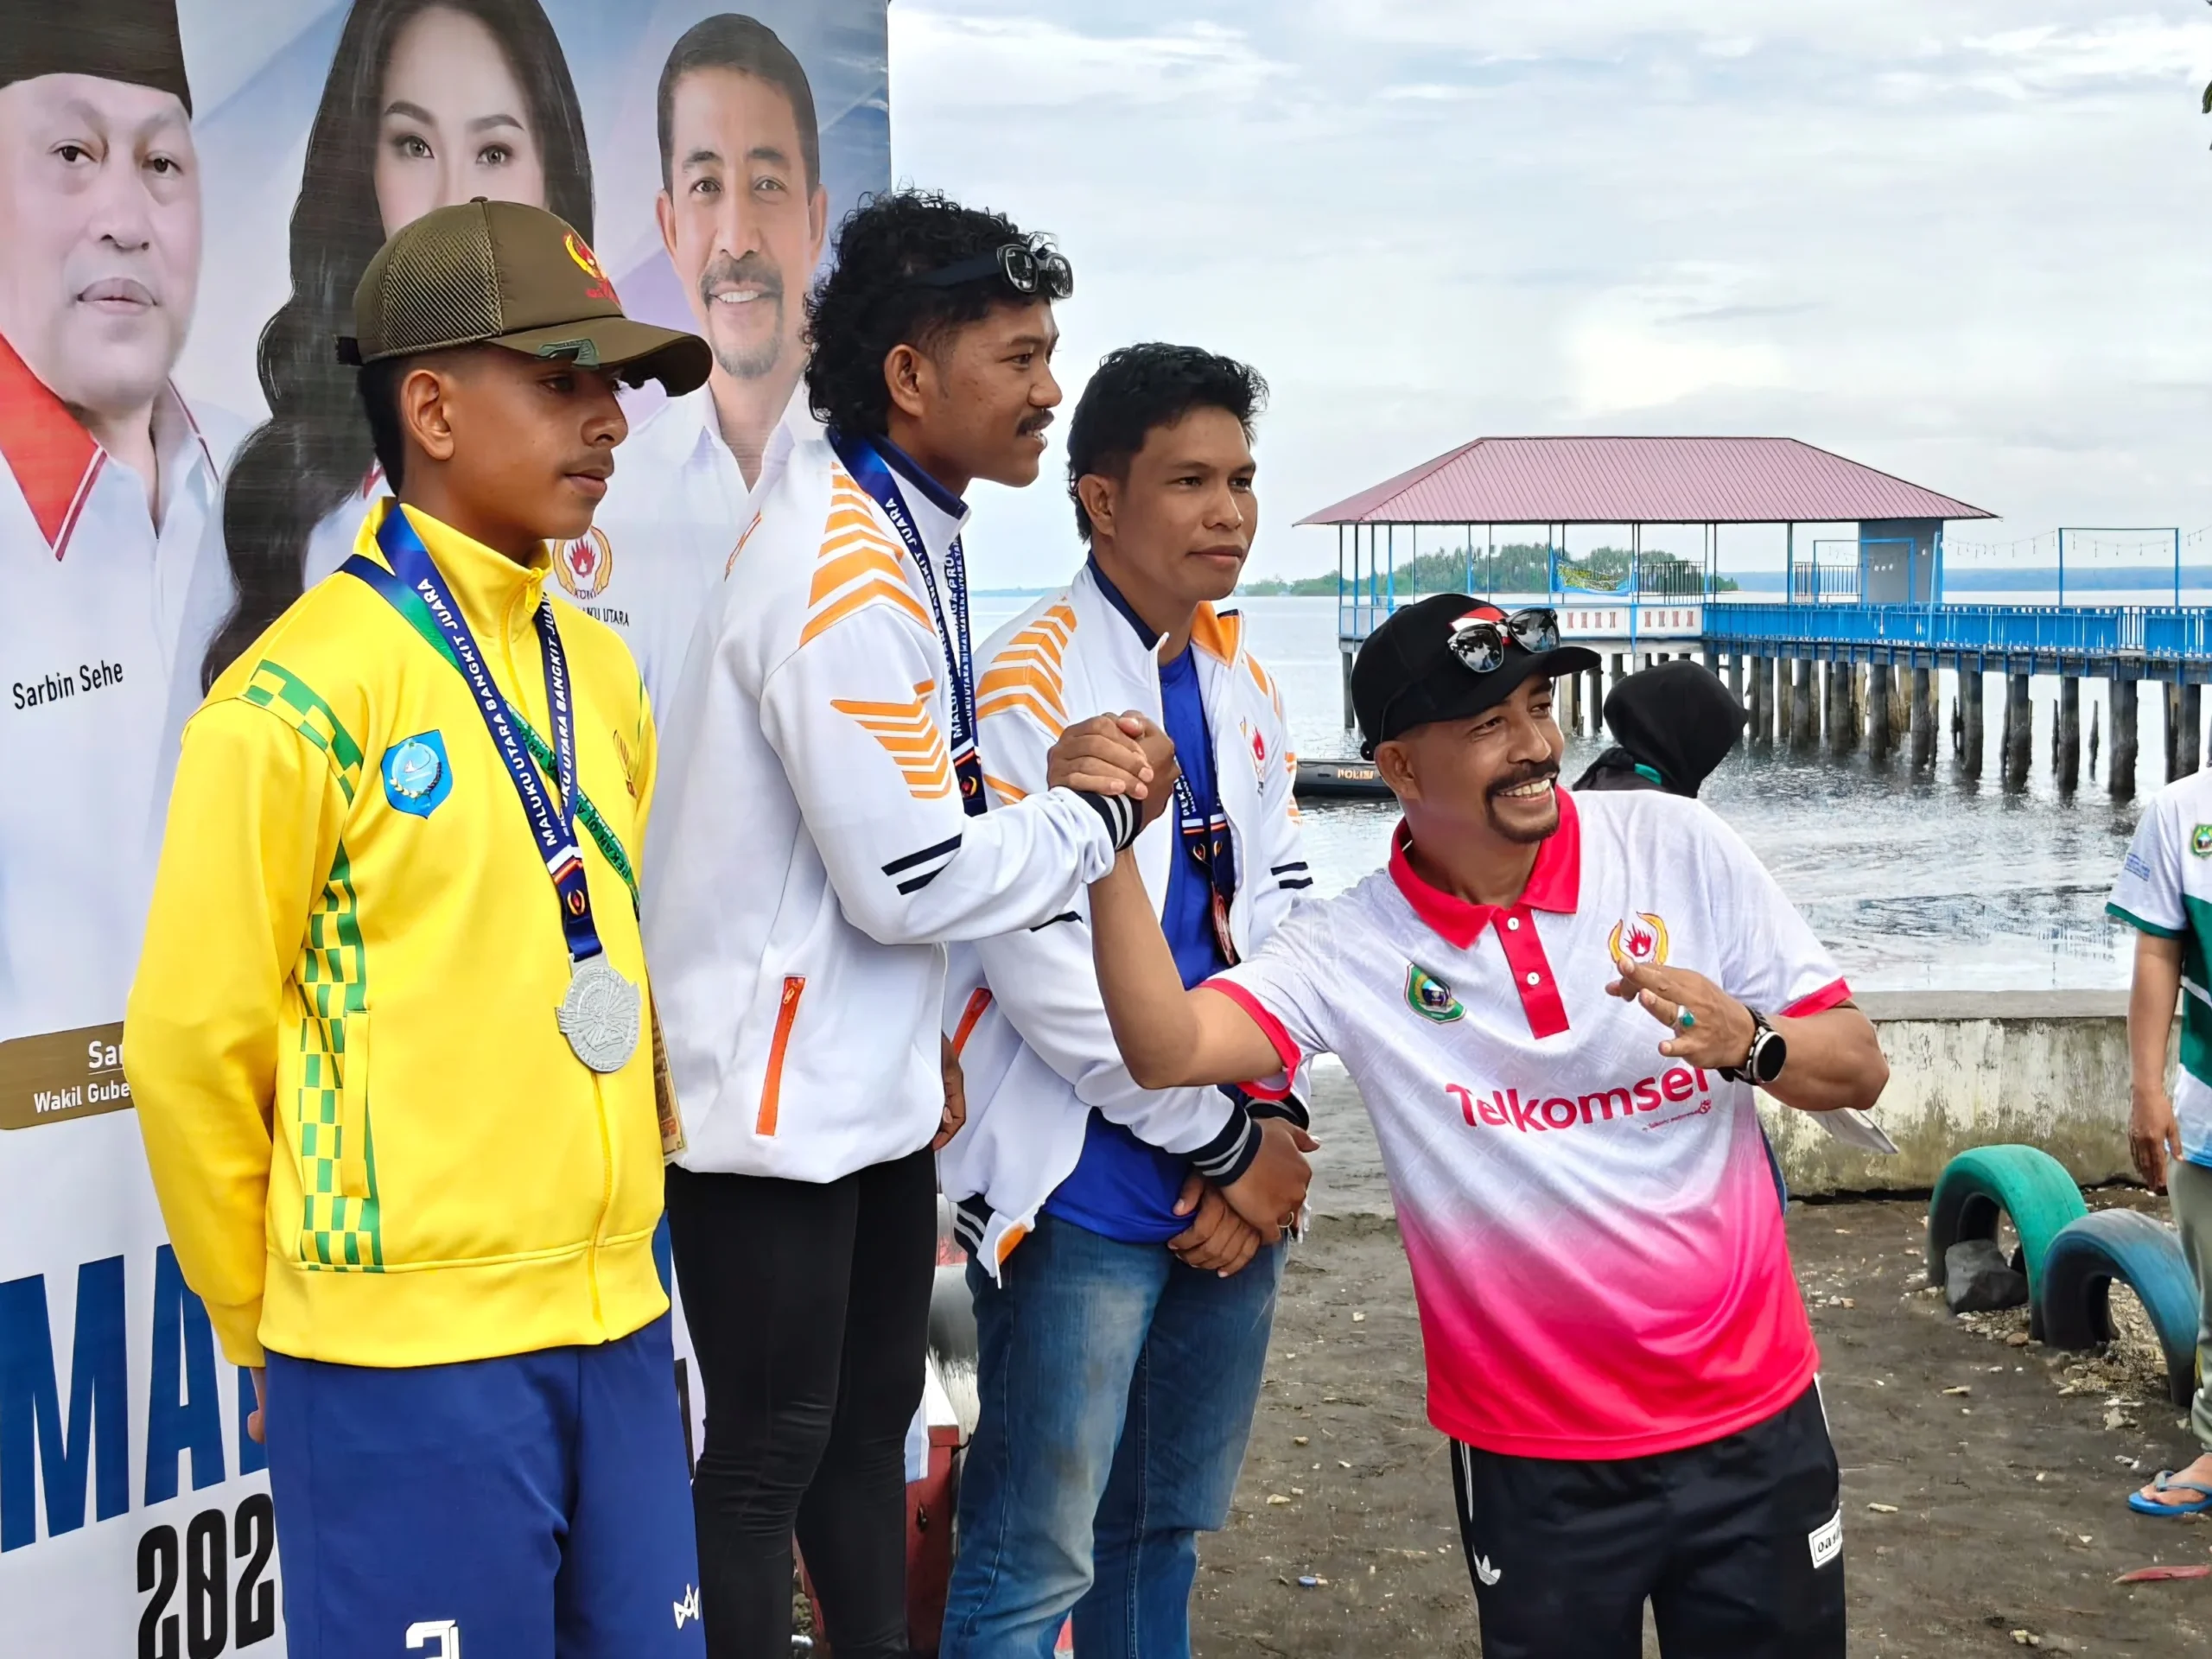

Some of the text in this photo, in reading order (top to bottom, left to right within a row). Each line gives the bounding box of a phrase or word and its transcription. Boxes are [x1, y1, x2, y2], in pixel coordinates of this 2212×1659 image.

[886, 498, 918, 546] JUARA
[417, 578, 459, 630] JUARA
[914, 551, 941, 619] BANGKIT
[603, 607, 630, 627] UTARA
[12, 659, 124, 710] Sarbin Sehe
[453, 636, 498, 711] BANGKIT
[547, 636, 568, 713] BANGKIT
[493, 713, 525, 769] UTARA
[557, 715, 572, 769] UTARA
[518, 772, 557, 847] MALUKU
[34, 1080, 131, 1114] Wakil Gube
[1445, 1066, 1709, 1132] Telkomsel
